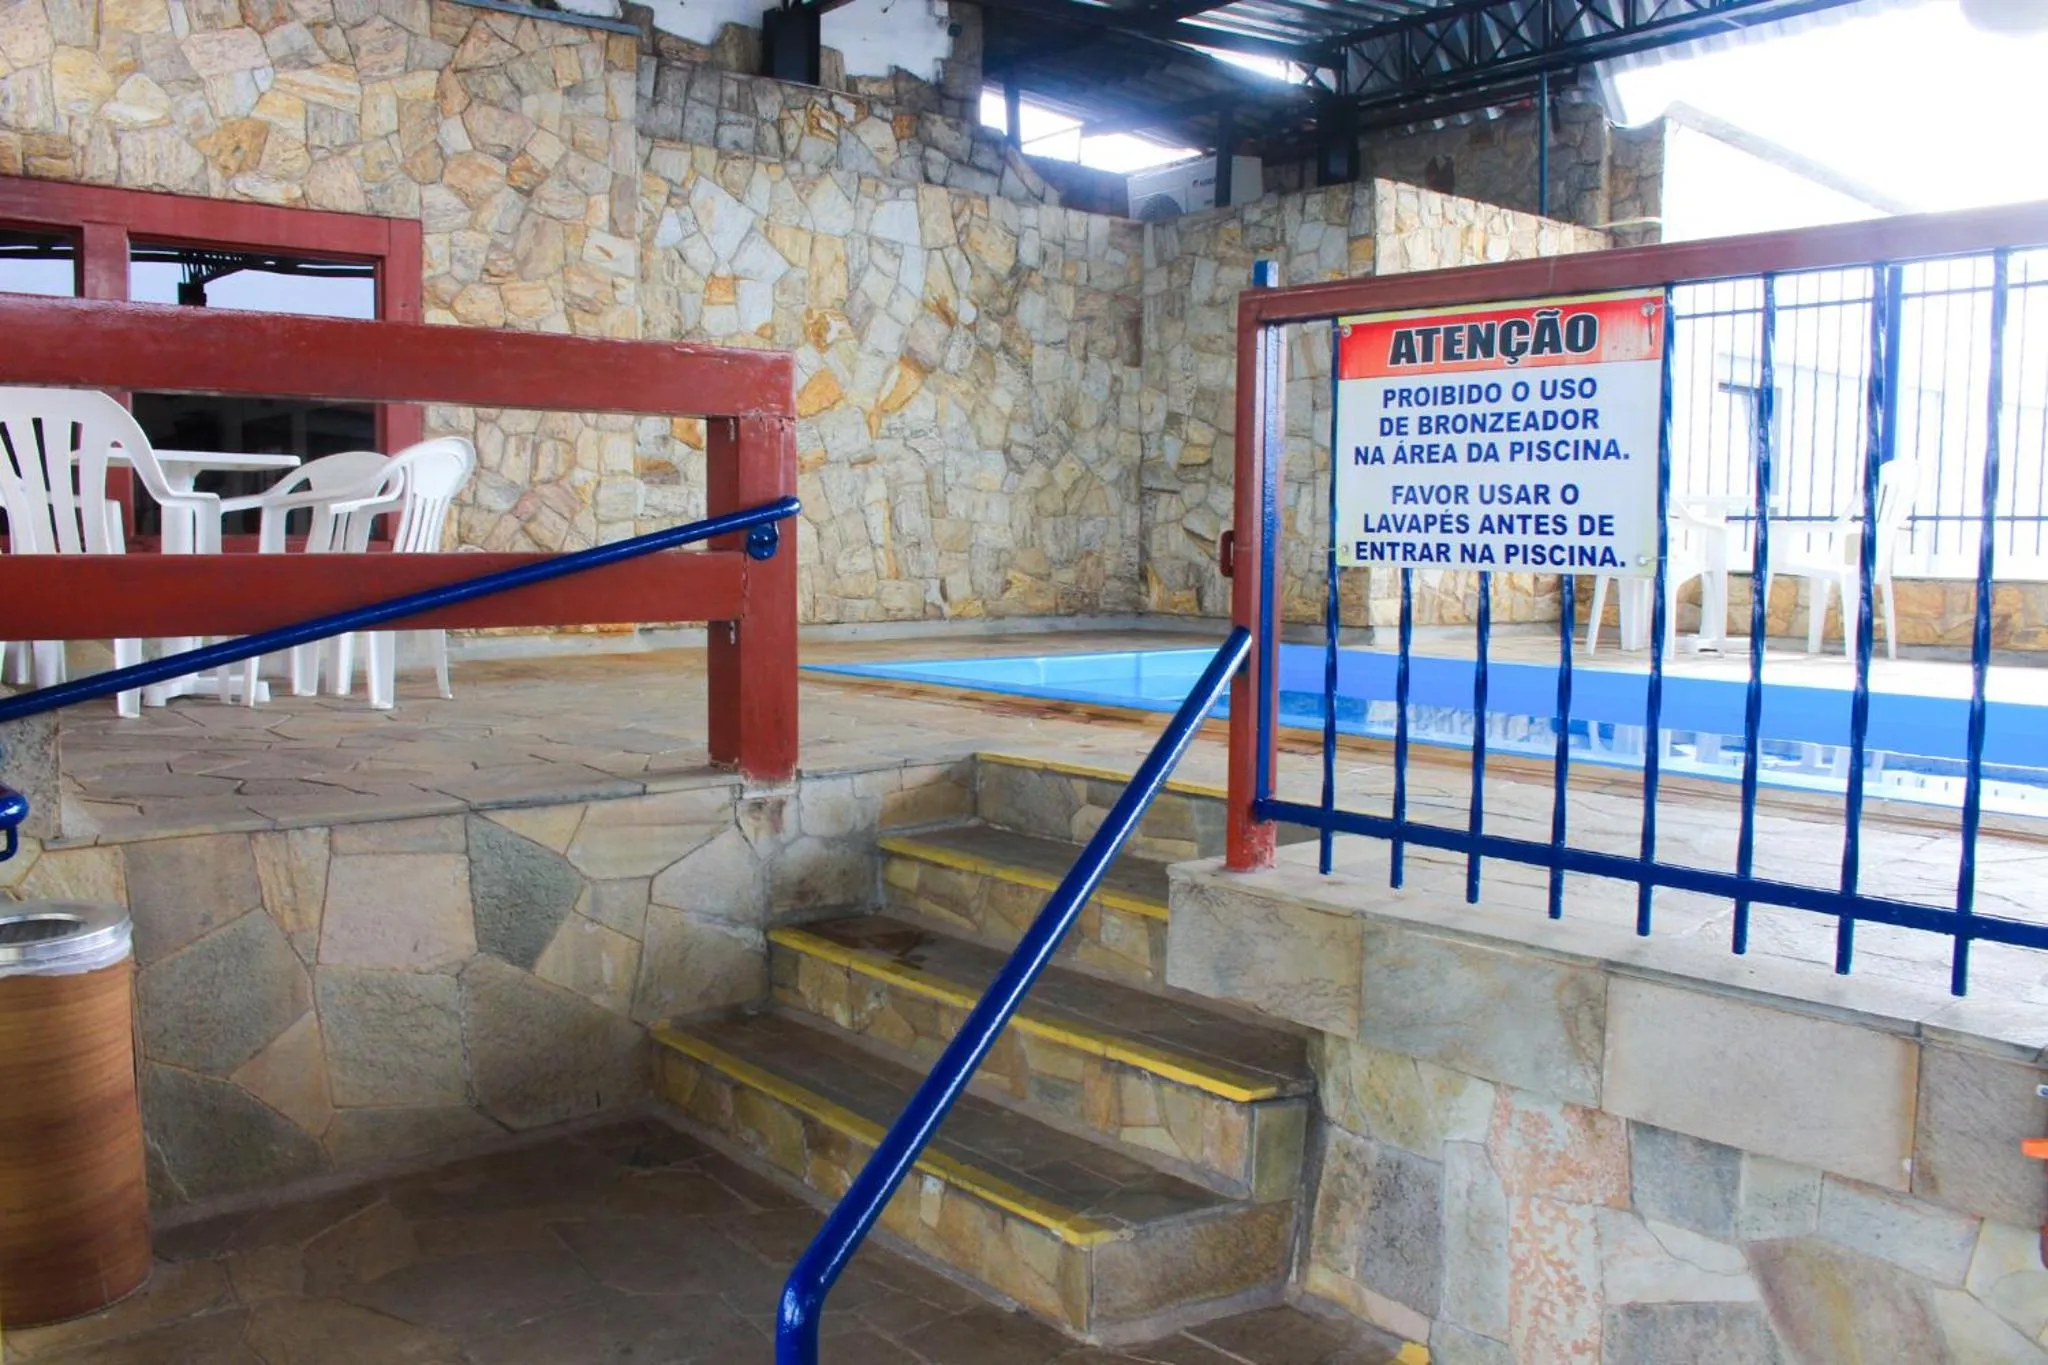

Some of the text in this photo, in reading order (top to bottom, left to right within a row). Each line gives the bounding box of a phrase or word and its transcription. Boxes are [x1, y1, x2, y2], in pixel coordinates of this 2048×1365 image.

[1387, 309, 1599, 365] ATENÇÃO
[1382, 376, 1598, 409] PROIBIDO O USO
[1379, 407, 1600, 438] DE BRONZEADOR
[1354, 438, 1630, 466] NA ÁREA DA PISCINA.
[1391, 482, 1580, 506] FAVOR USAR O
[1363, 508, 1615, 537] LAVAPÉS ANTES DE
[1355, 540, 1627, 568] ENTRAR NA PISCINA.
